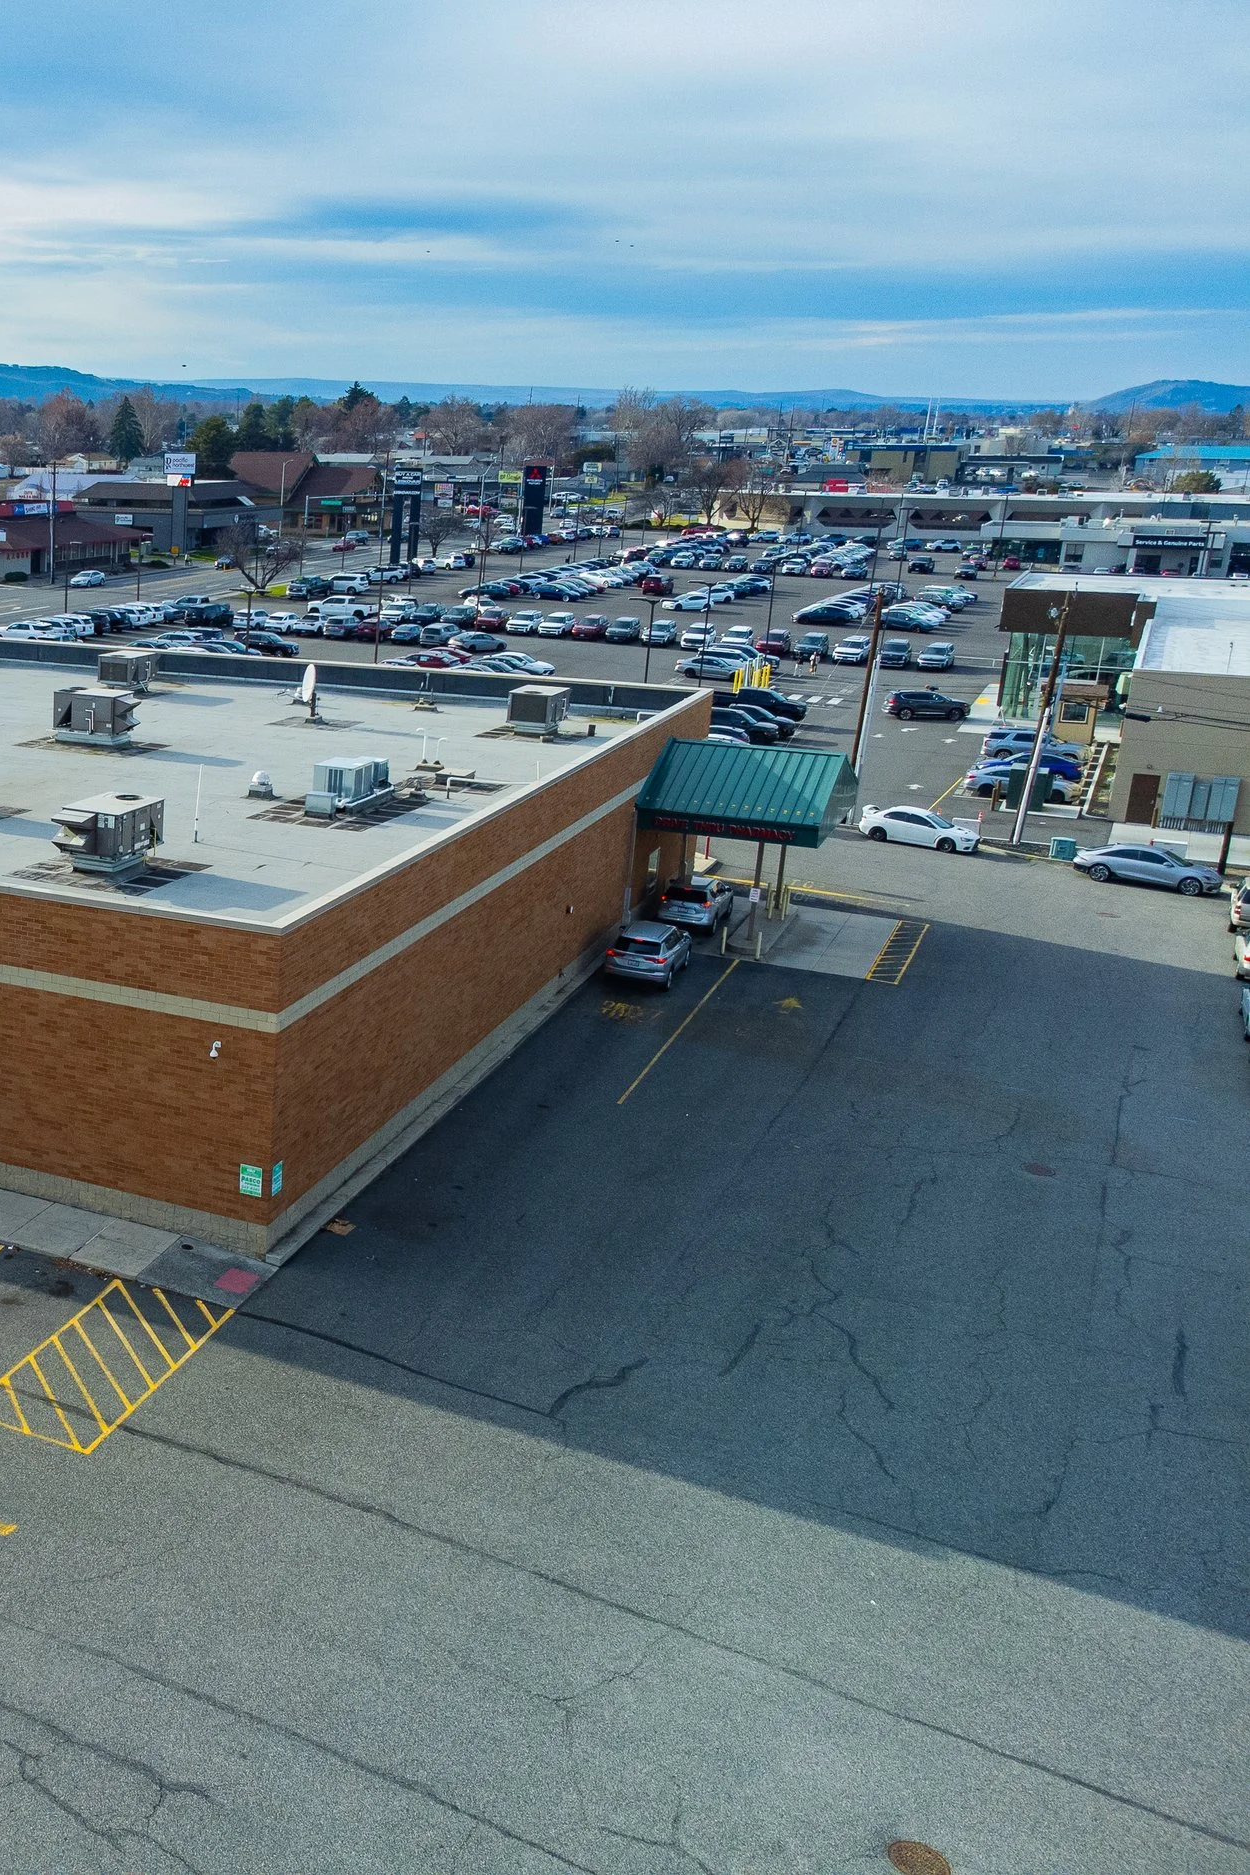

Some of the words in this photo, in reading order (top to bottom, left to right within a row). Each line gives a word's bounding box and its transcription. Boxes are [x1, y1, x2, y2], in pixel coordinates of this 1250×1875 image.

[654, 816, 689, 830] DRIVE
[693, 820, 725, 833] THRU
[728, 824, 796, 841] PHARMACY
